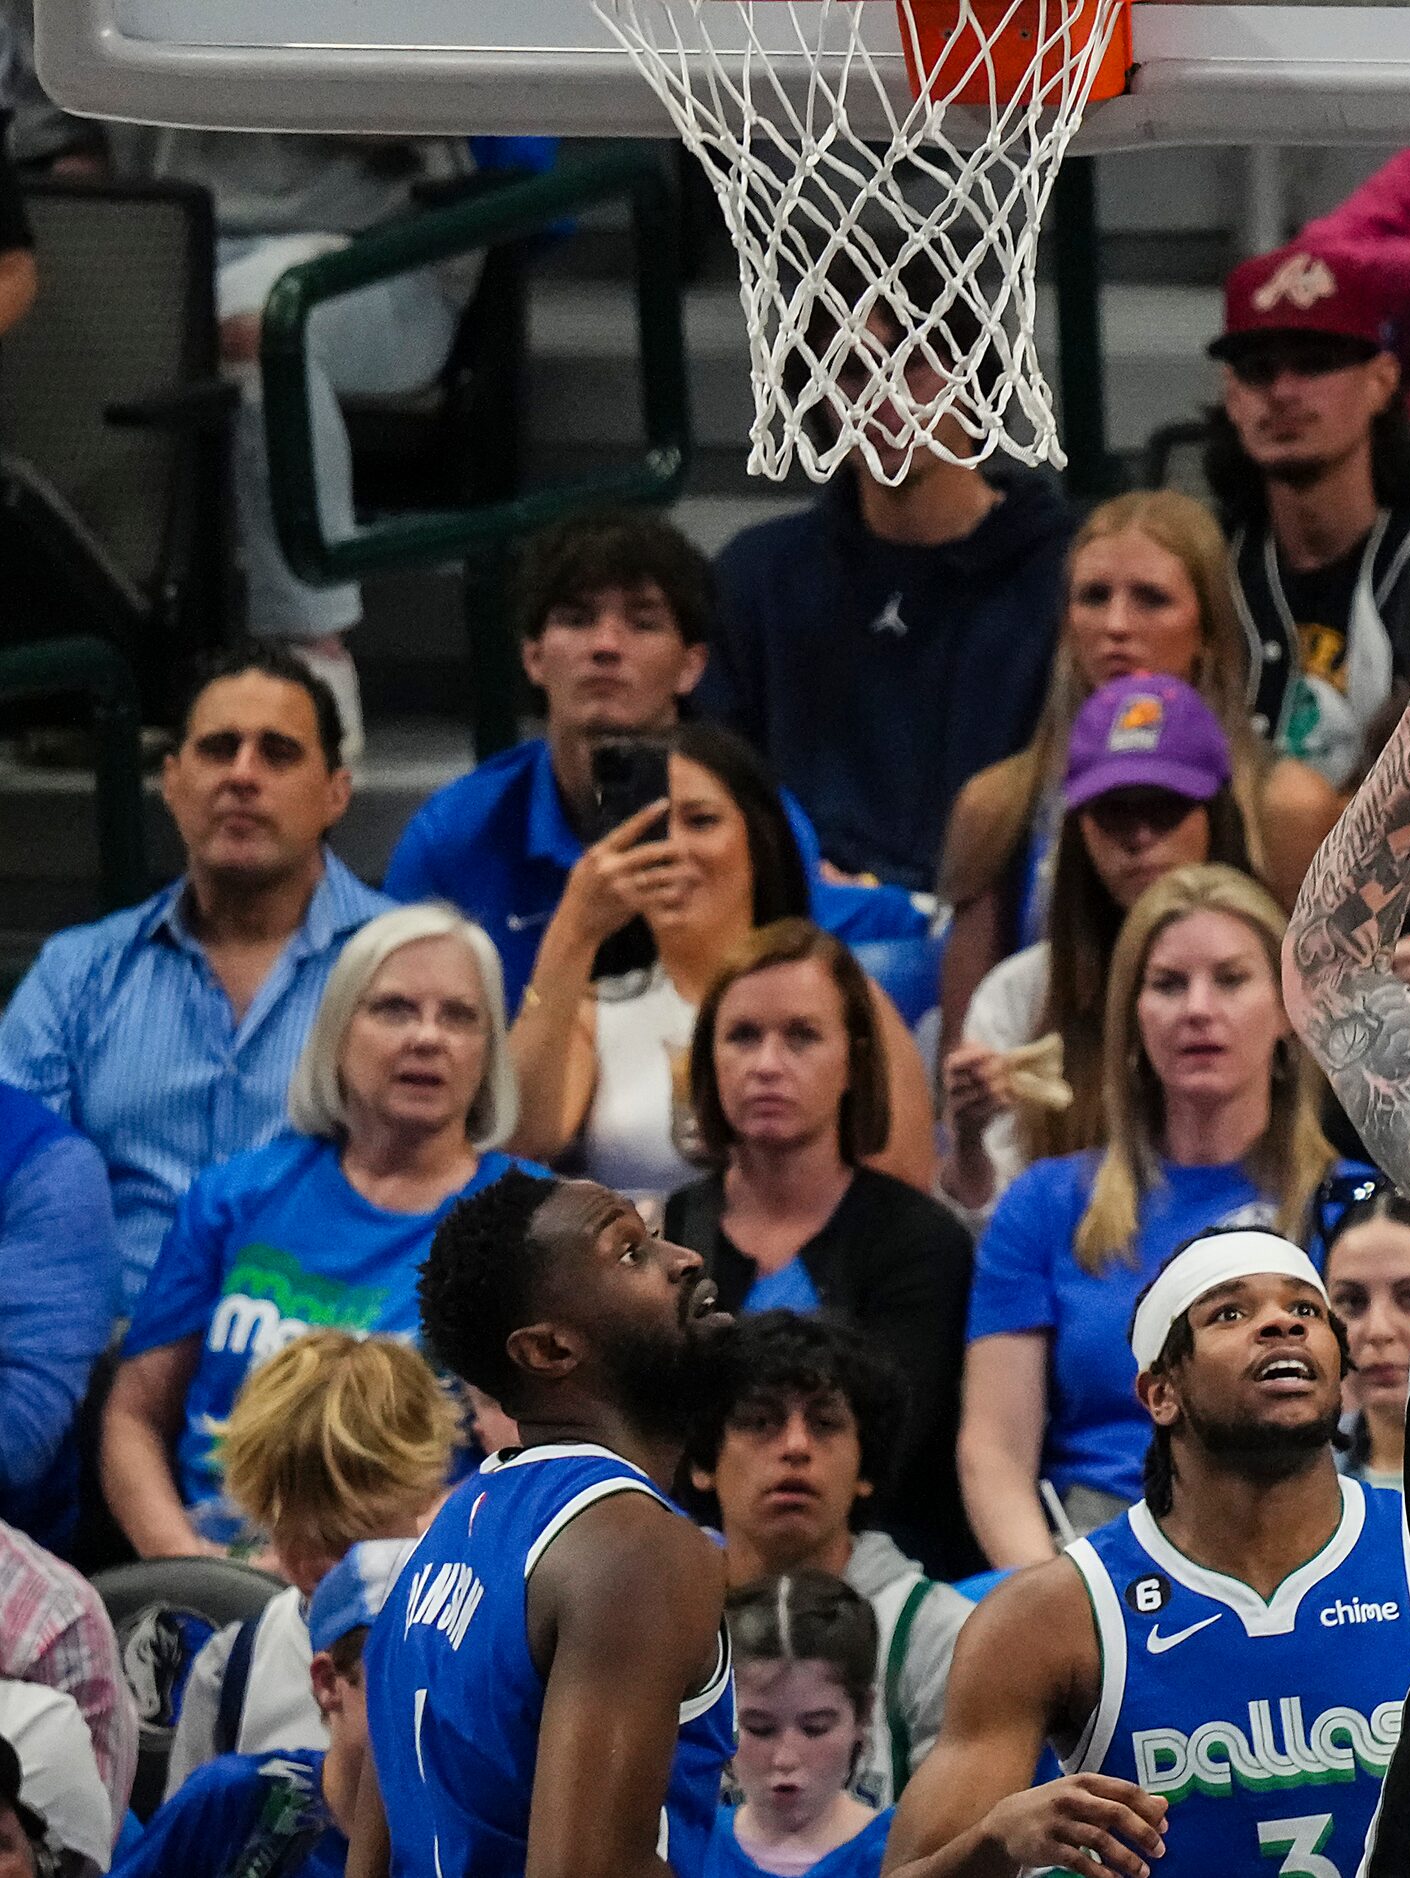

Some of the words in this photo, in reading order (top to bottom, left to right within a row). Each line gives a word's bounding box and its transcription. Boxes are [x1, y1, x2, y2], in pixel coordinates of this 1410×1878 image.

[1135, 1577, 1163, 1613] 6
[1319, 1596, 1401, 1628] chime
[1131, 1695, 1407, 1804] Dallas
[1256, 1812, 1343, 1878] 3
